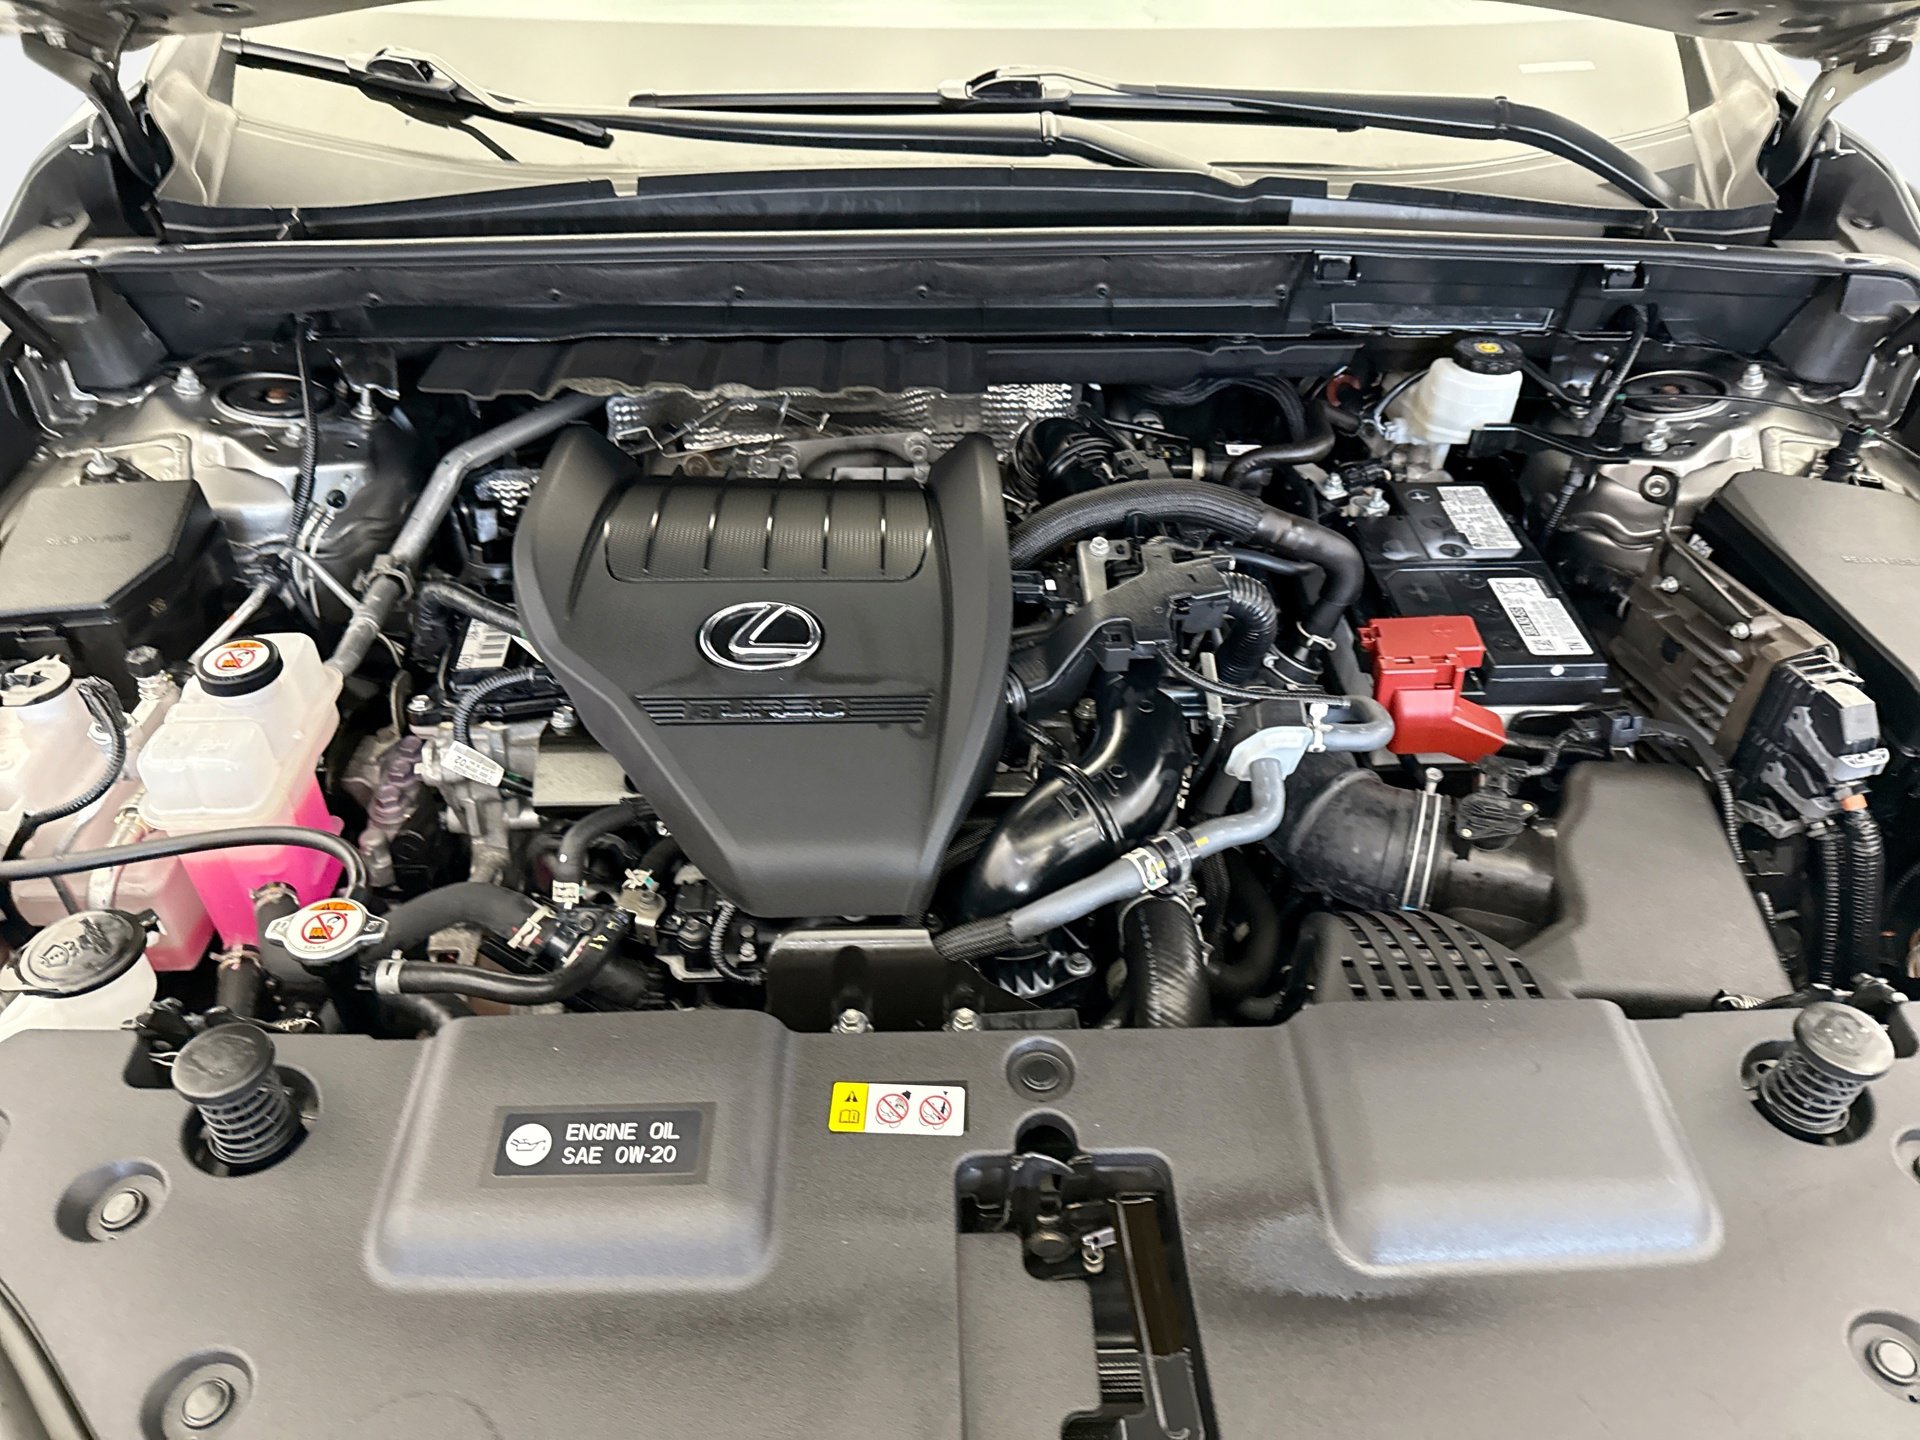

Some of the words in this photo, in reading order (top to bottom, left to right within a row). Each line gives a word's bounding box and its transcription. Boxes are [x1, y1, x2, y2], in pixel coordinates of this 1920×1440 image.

[565, 1123, 638, 1141] ENGINE
[649, 1121, 680, 1140] OIL
[561, 1146, 604, 1165] SAE
[614, 1145, 677, 1164] 0W-20
